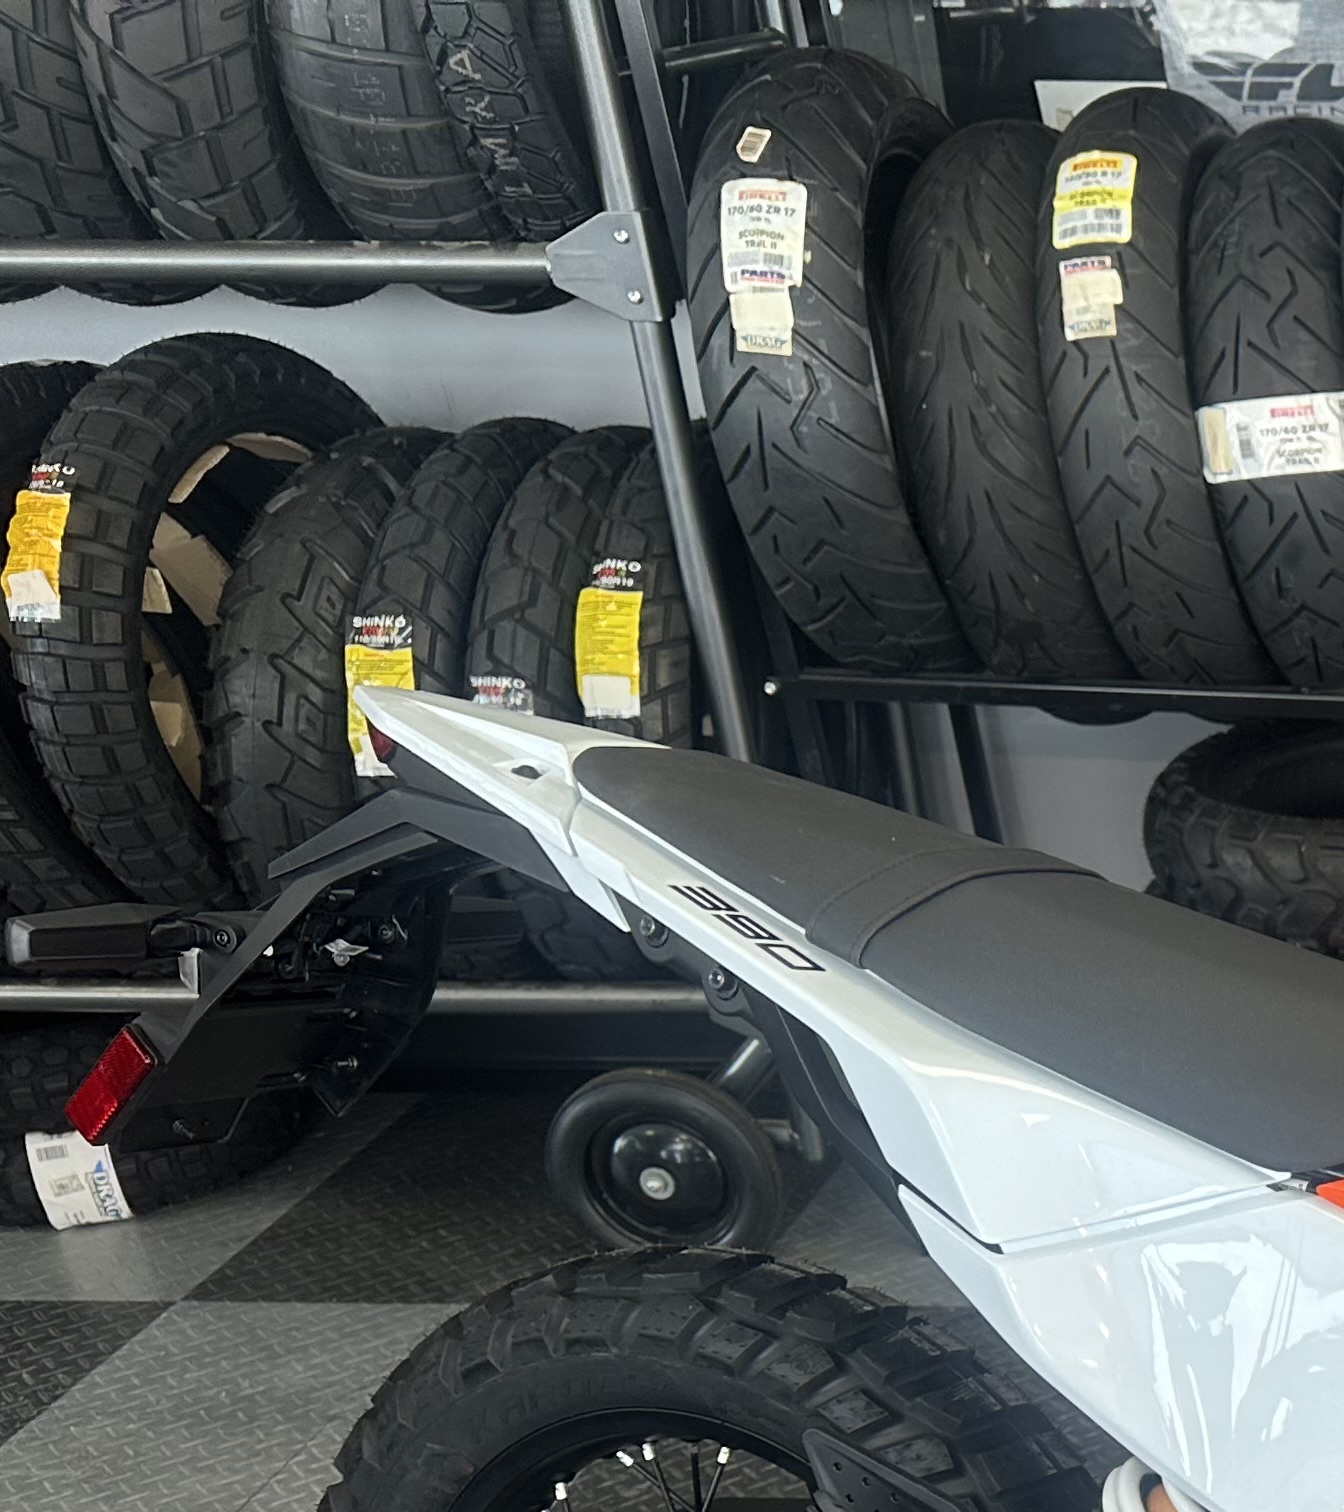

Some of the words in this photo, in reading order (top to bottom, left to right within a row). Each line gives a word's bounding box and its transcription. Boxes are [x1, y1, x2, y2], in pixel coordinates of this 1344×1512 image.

[784, 206, 797, 218] 17
[353, 614, 406, 628] SHINKO
[469, 675, 526, 689] SHINKO
[667, 884, 827, 972] 390
